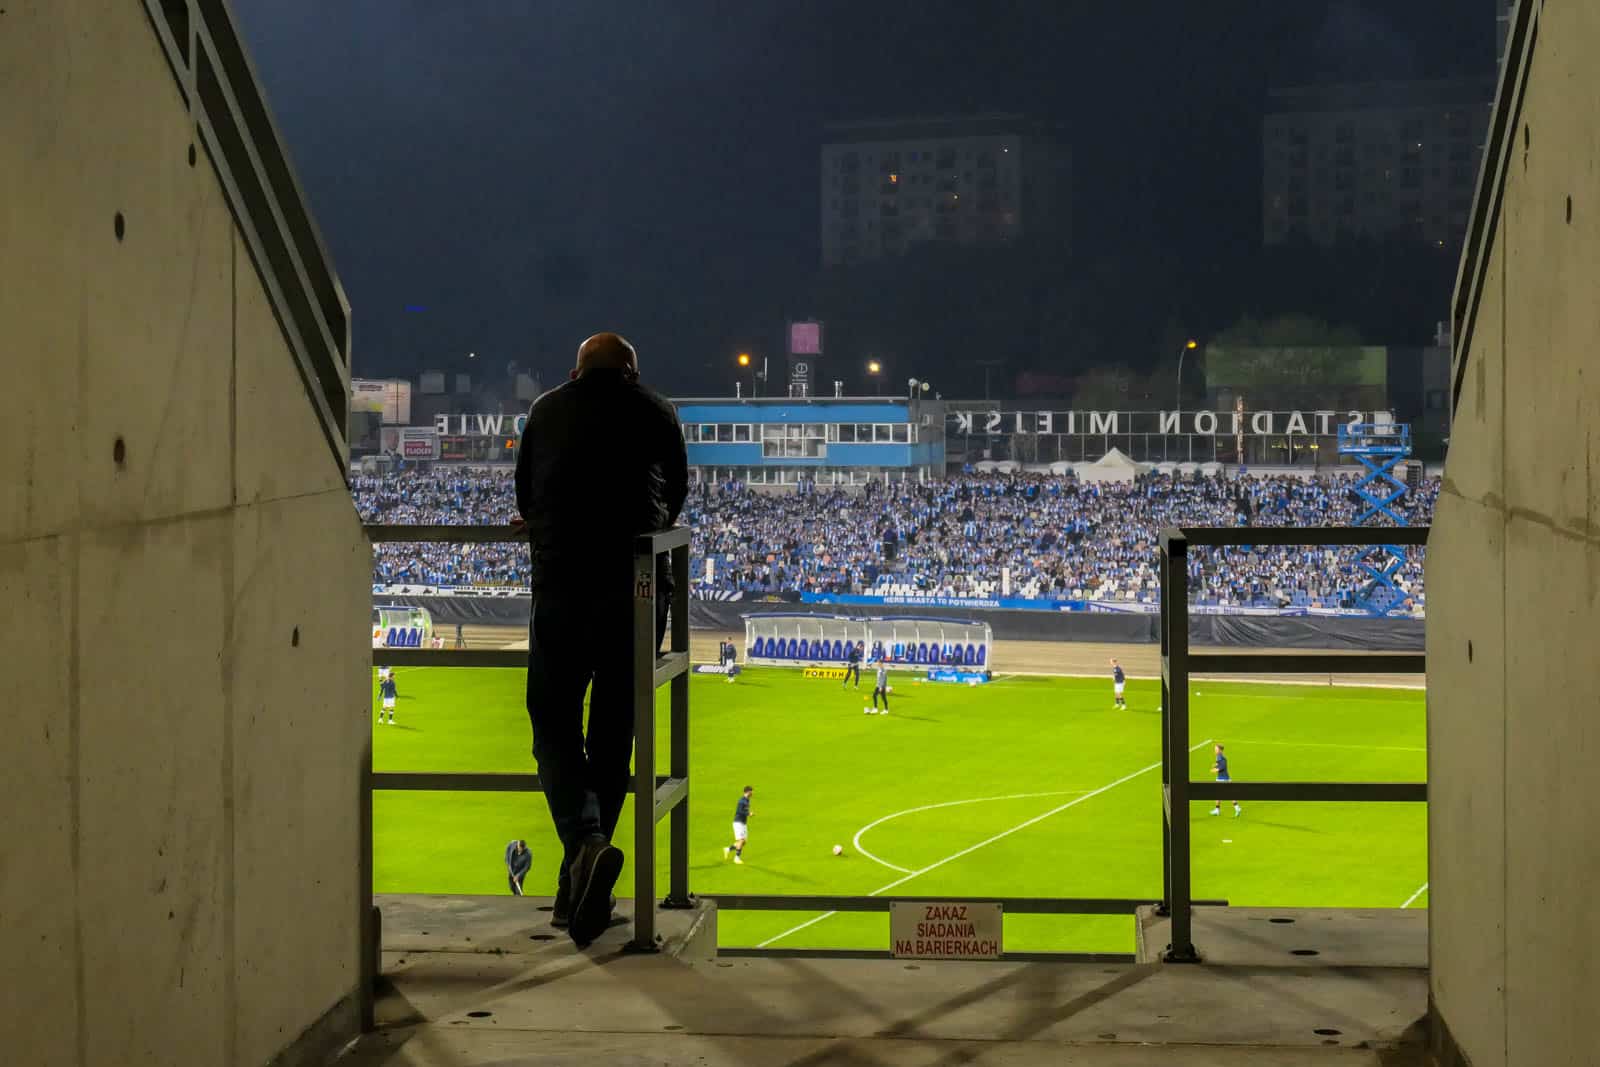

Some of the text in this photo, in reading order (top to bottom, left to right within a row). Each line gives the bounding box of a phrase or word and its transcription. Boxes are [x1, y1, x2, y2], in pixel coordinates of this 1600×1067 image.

[948, 598, 1000, 607] POTWIERDZA
[925, 906, 967, 920] ZAKAZ
[917, 923, 976, 937] SIADANIA
[896, 941, 998, 955] NA BARIERKACH
